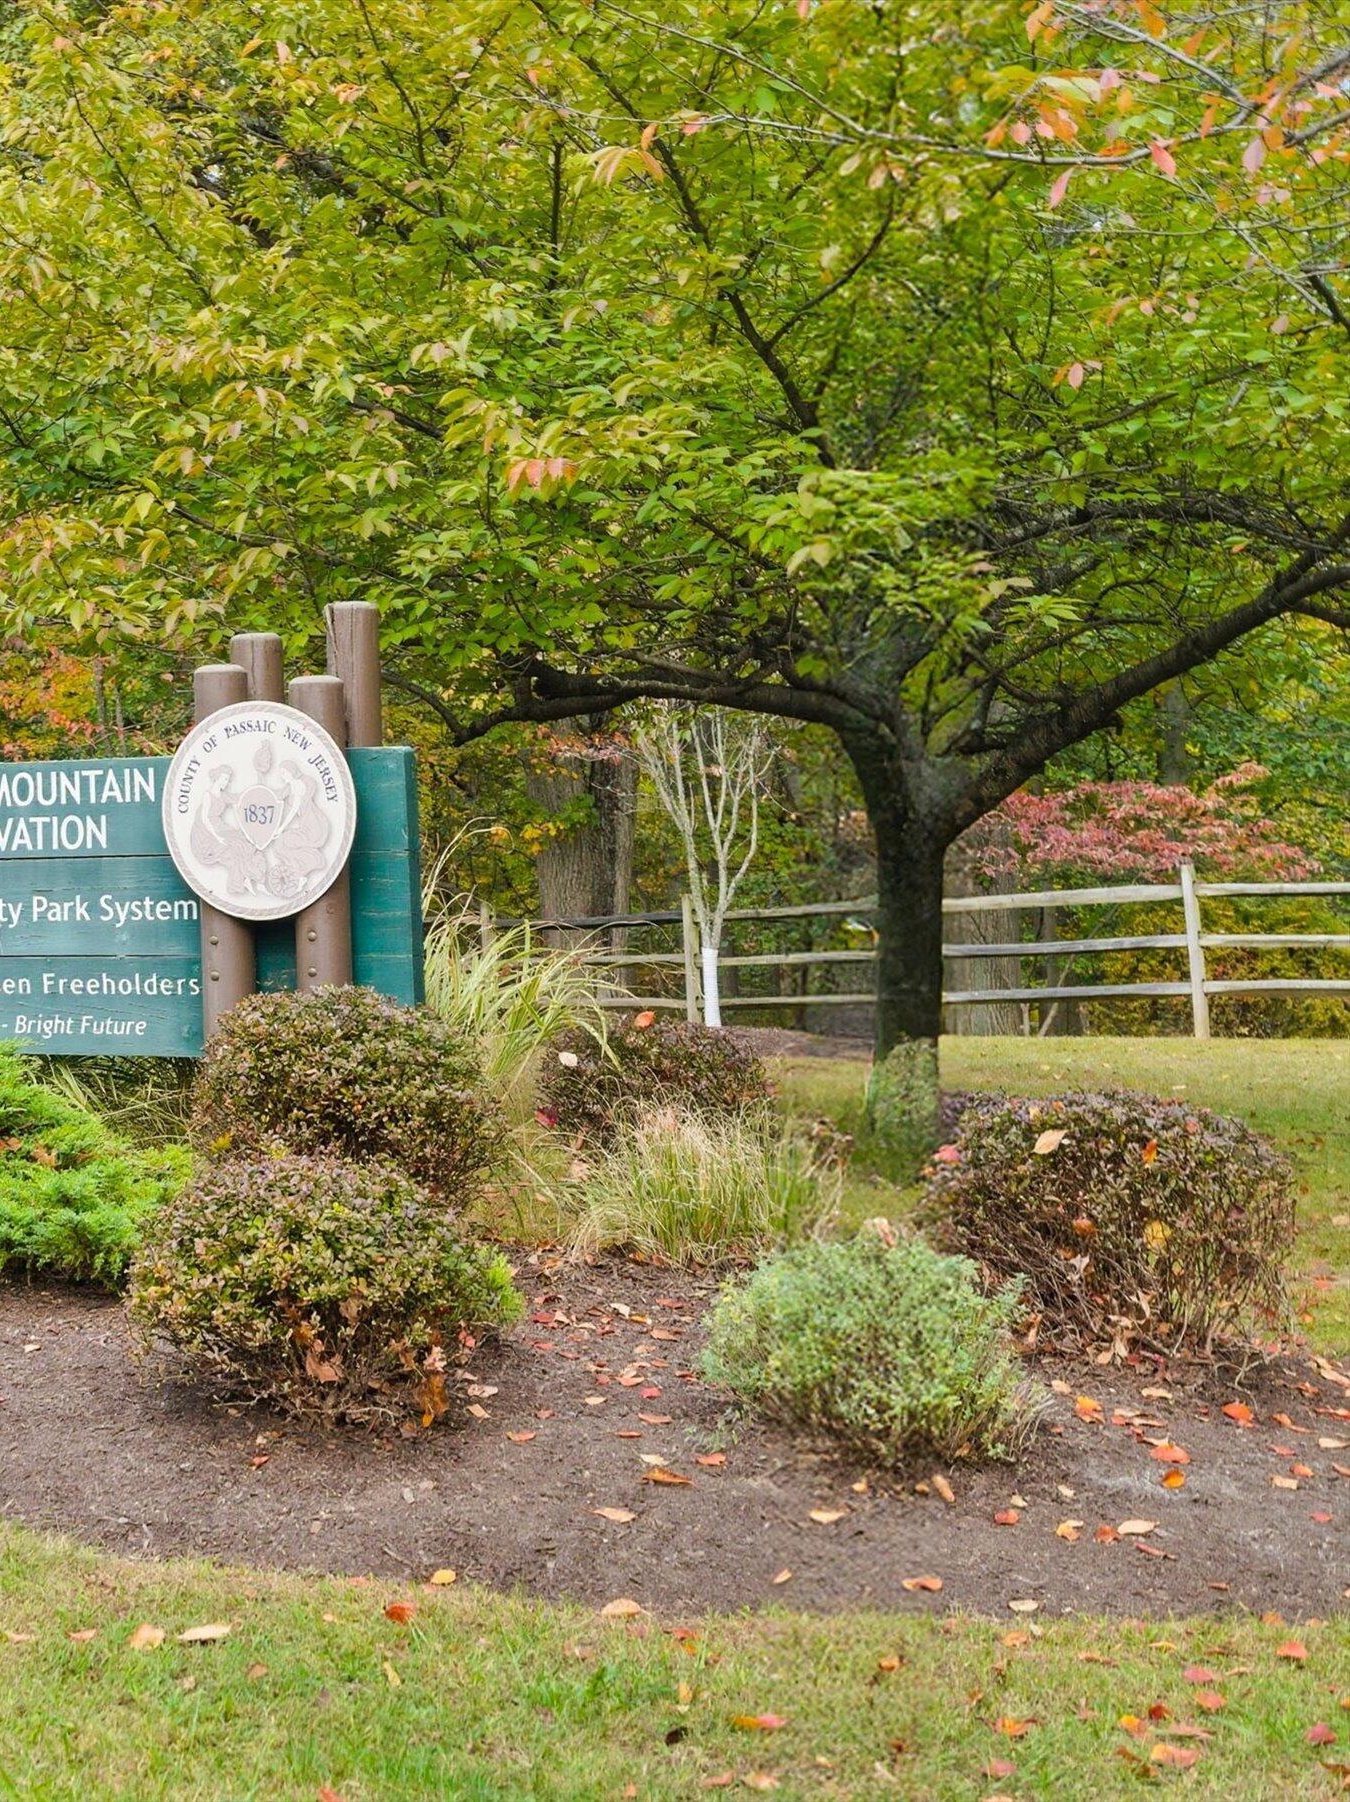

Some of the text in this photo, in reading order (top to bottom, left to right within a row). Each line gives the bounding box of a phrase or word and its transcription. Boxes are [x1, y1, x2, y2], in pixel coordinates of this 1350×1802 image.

[178, 719, 339, 814] COUNTY OF PASSAIC NEW JERSEY
[244, 804, 275, 825] 1837
[32, 895, 92, 922] Park
[100, 894, 199, 928] System
[42, 973, 200, 995] Freeholders
[14, 1014, 74, 1038] Bright
[80, 1016, 147, 1035] Future
